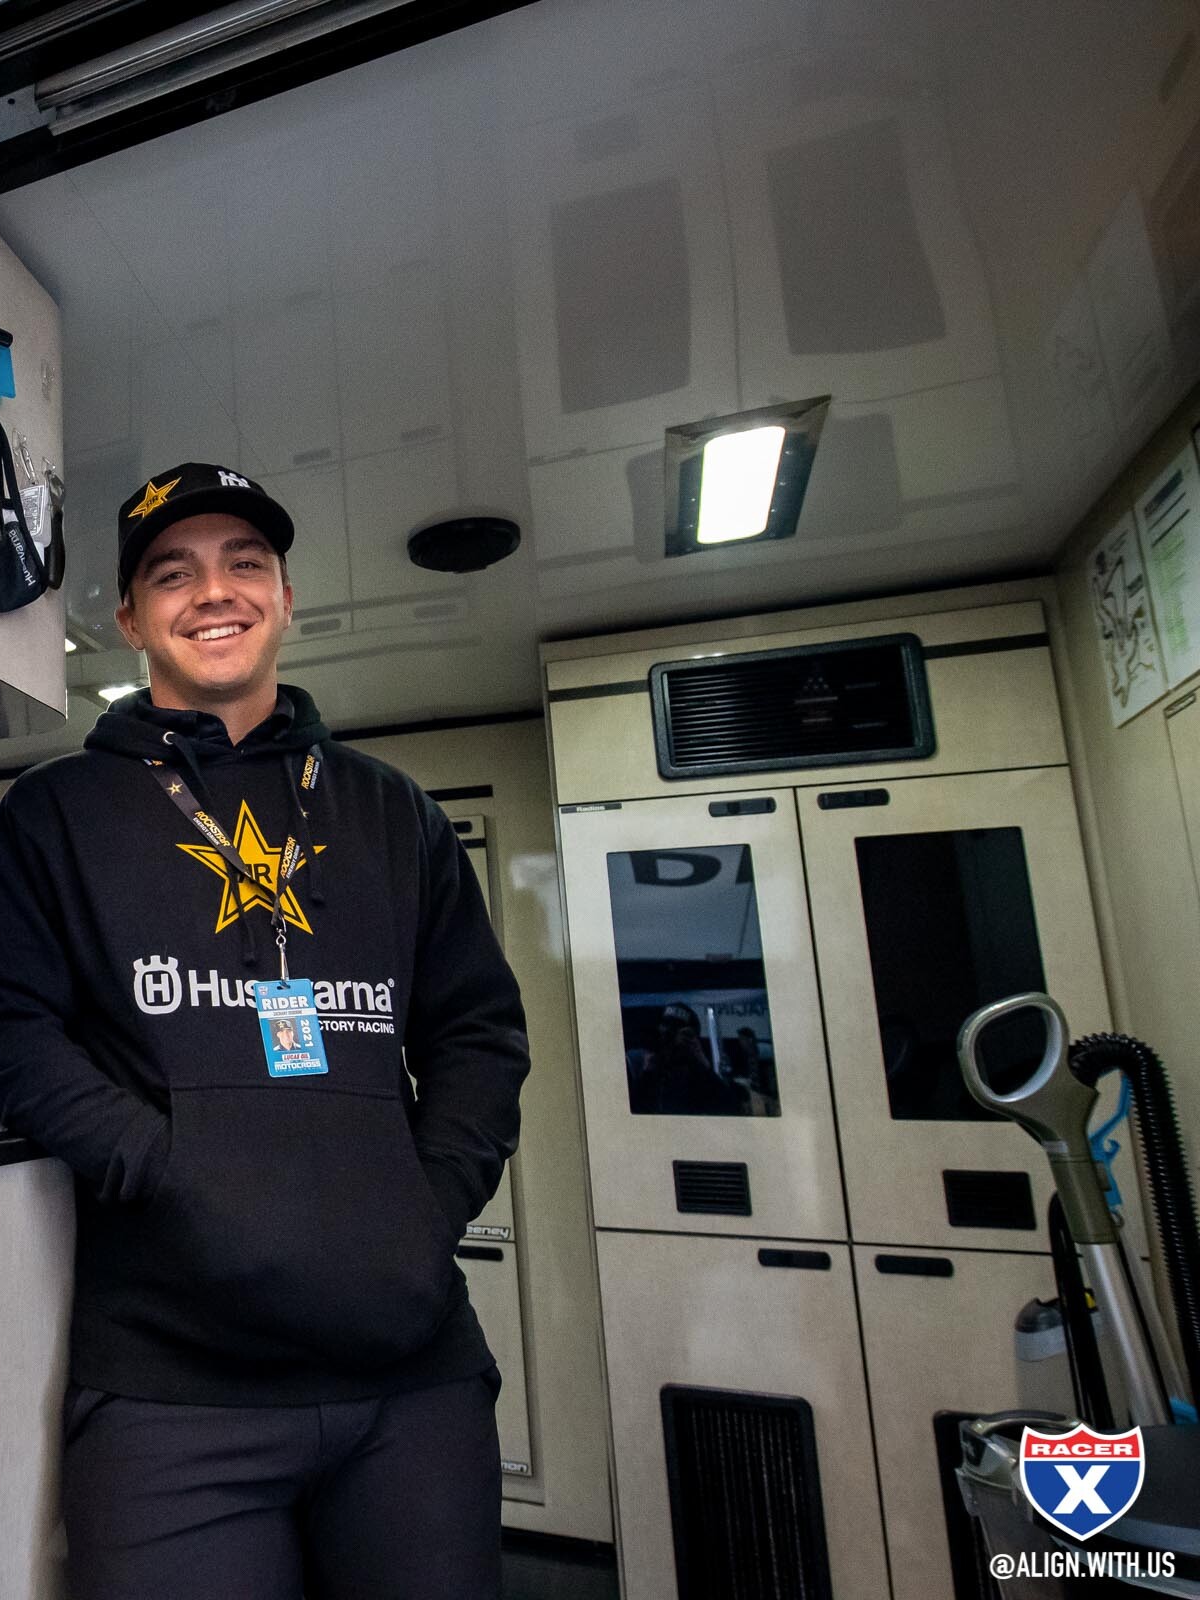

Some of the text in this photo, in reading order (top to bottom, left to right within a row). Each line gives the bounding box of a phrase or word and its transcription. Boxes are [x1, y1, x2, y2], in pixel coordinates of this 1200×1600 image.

[195, 811, 230, 847] ROCKSTAR
[261, 996, 309, 1010] RIDER
[301, 1020, 313, 1047] 2021
[358, 1021, 394, 1034] RACING
